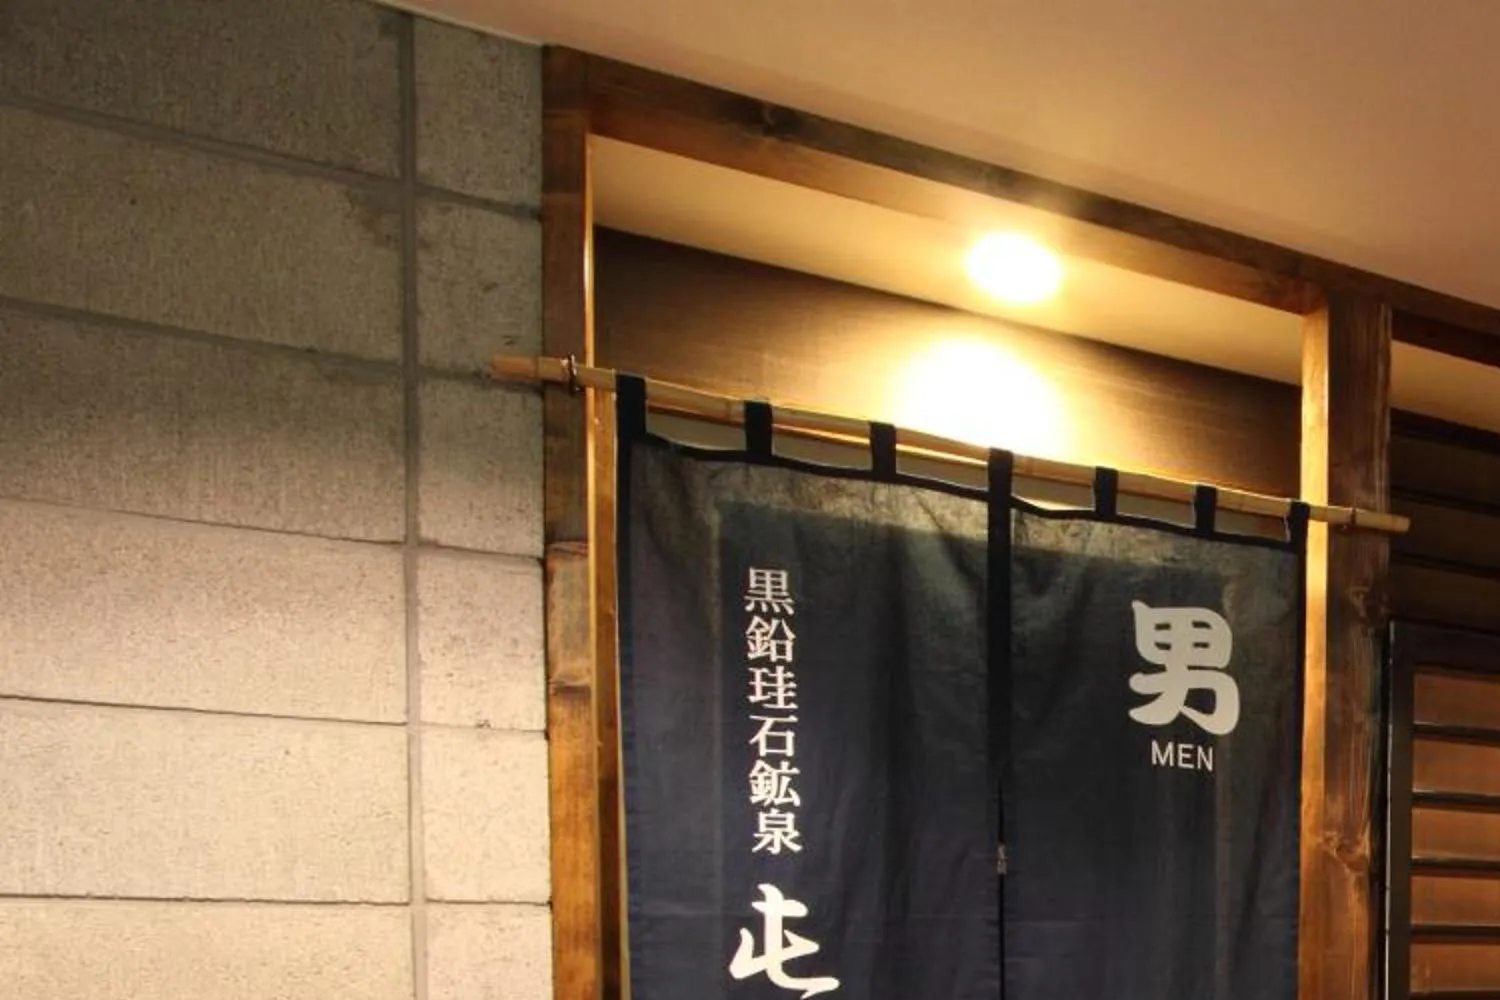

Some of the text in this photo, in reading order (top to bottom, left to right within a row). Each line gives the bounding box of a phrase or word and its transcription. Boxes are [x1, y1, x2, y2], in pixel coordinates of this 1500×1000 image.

[744, 566, 803, 855] 黒鉛珪石鉱泉
[1128, 600, 1240, 735] 男
[1150, 740, 1214, 772] MEN
